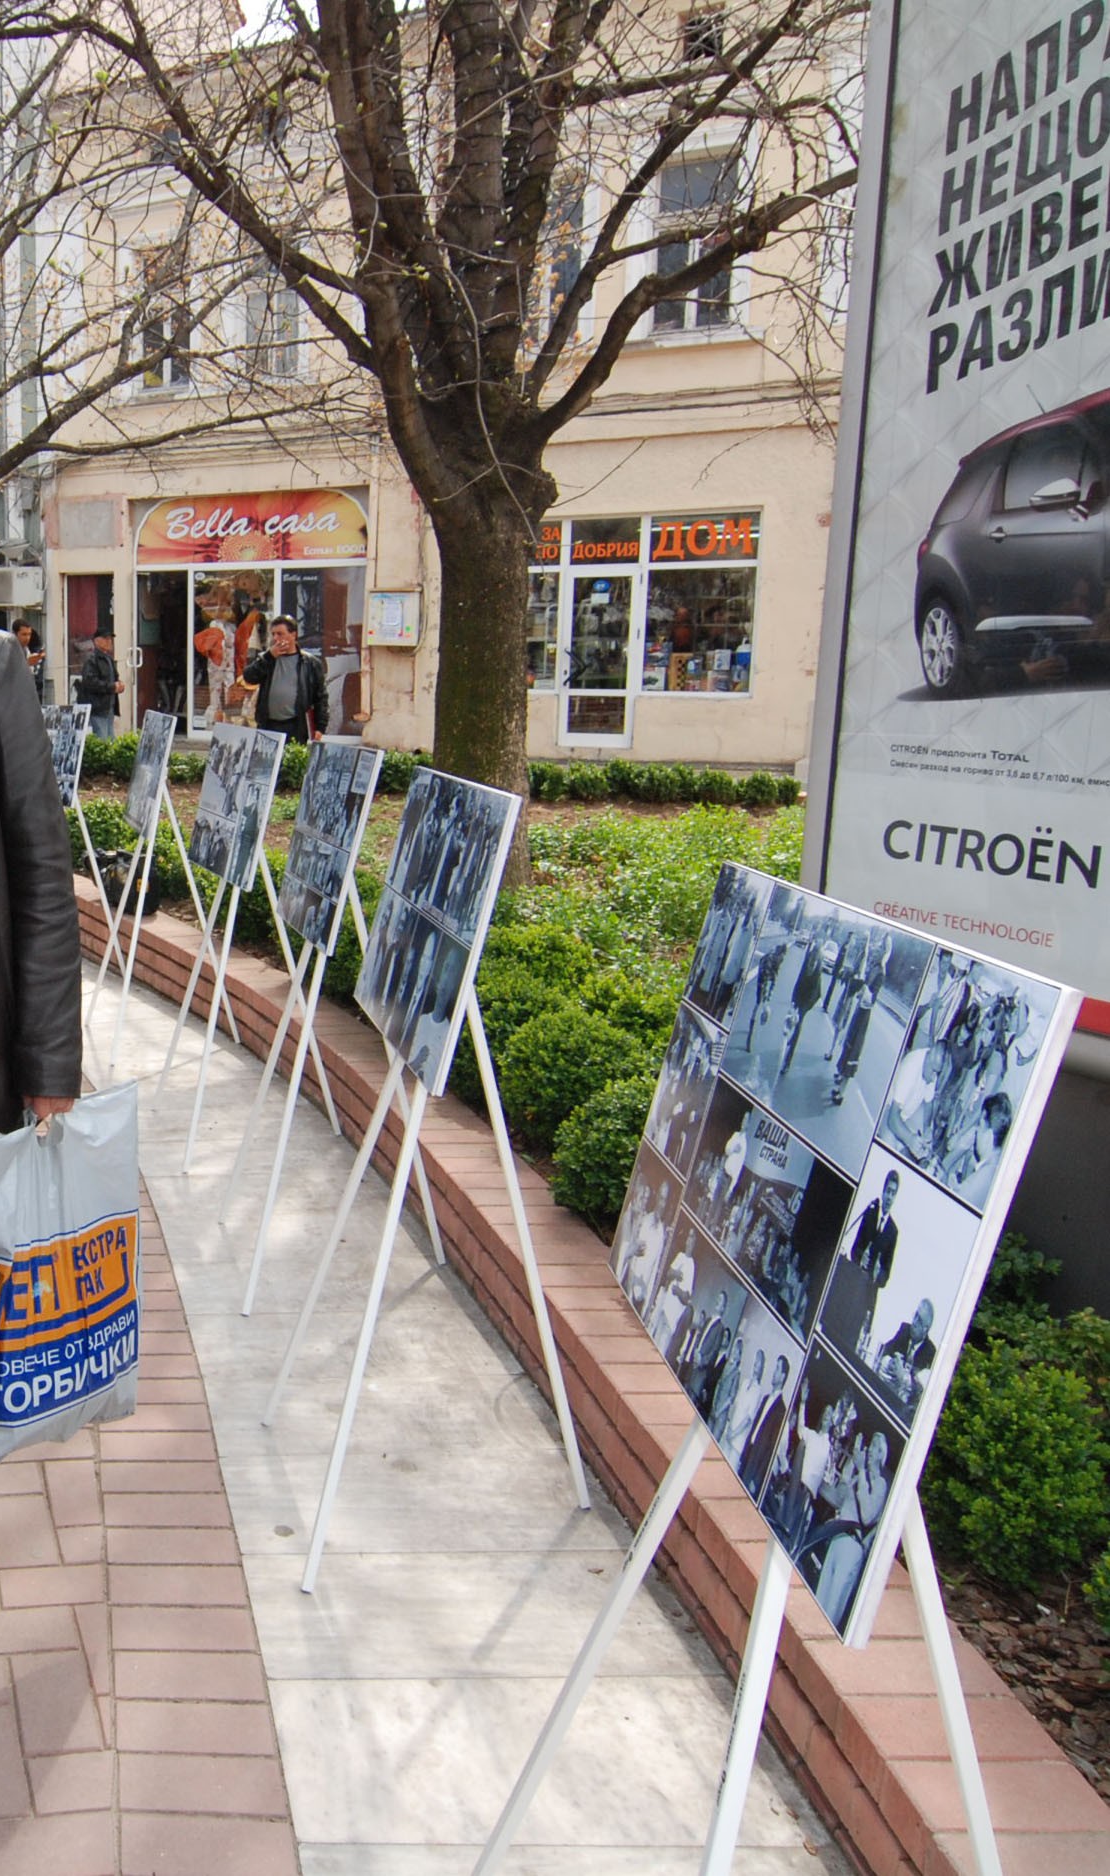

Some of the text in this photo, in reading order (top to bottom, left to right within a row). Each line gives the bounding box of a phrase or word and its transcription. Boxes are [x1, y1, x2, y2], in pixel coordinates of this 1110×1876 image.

[946, 0, 1110, 156] НАПР
[938, 76, 1110, 237] НЕЩО
[927, 166, 1110, 317] ЖИВЕ
[926, 248, 1110, 394] РАЗЛИ
[165, 506, 339, 539] Bella casa
[541, 527, 561, 541] ЗА
[652, 518, 753, 561] ДОМ
[572, 540, 639, 559] ДОБРИЯ
[931, 748, 987, 759] предпочита
[883, 819, 1102, 889] CITROËN
[873, 900, 1055, 948] CRÉATIVE TECHNOLOGIE
[754, 1119, 789, 1151] ВАША
[759, 1146, 788, 1170] СТРАНА
[72, 1226, 127, 1271] ЕКСТРА
[65, 1339, 84, 1359] ОТ
